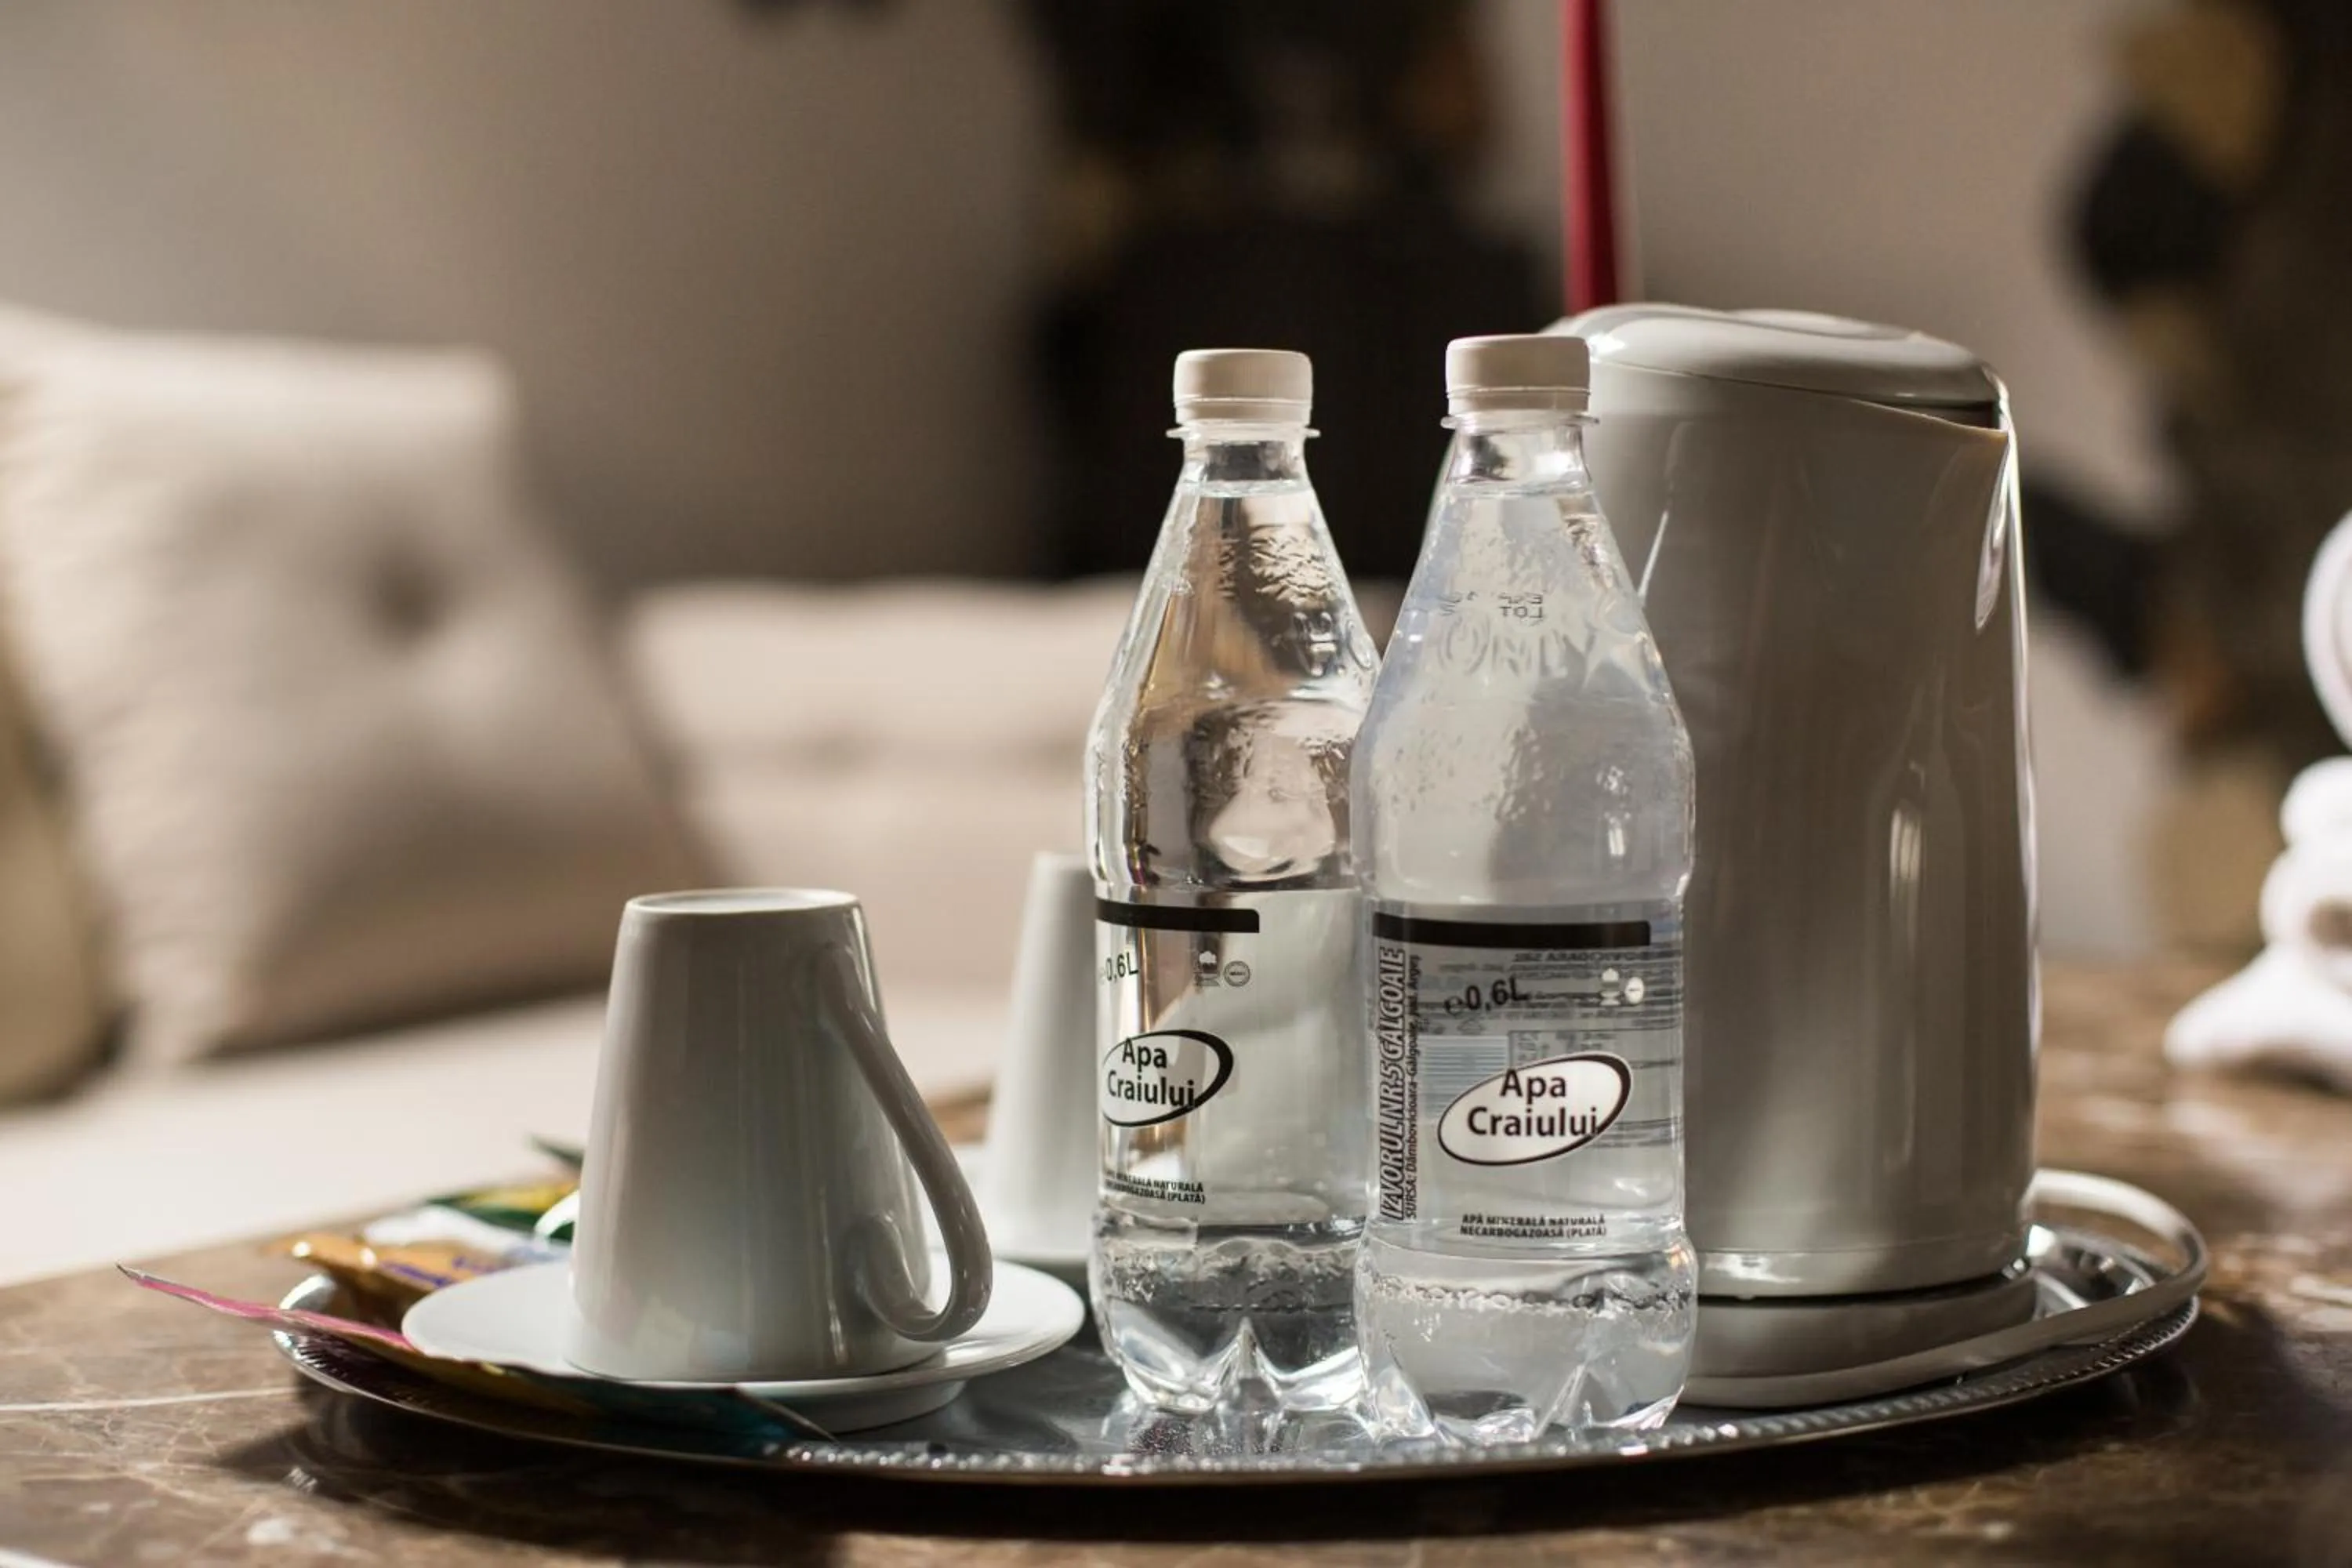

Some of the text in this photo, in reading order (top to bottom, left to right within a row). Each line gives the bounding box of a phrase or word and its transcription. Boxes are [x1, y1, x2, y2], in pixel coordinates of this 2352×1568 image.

[1122, 1038, 1167, 1073] Apa
[1108, 1069, 1195, 1108] Craiului
[1500, 1069, 1567, 1105] Apa
[1467, 1105, 1598, 1137] Craiului
[1379, 1120, 1404, 1221] IZVORUL
